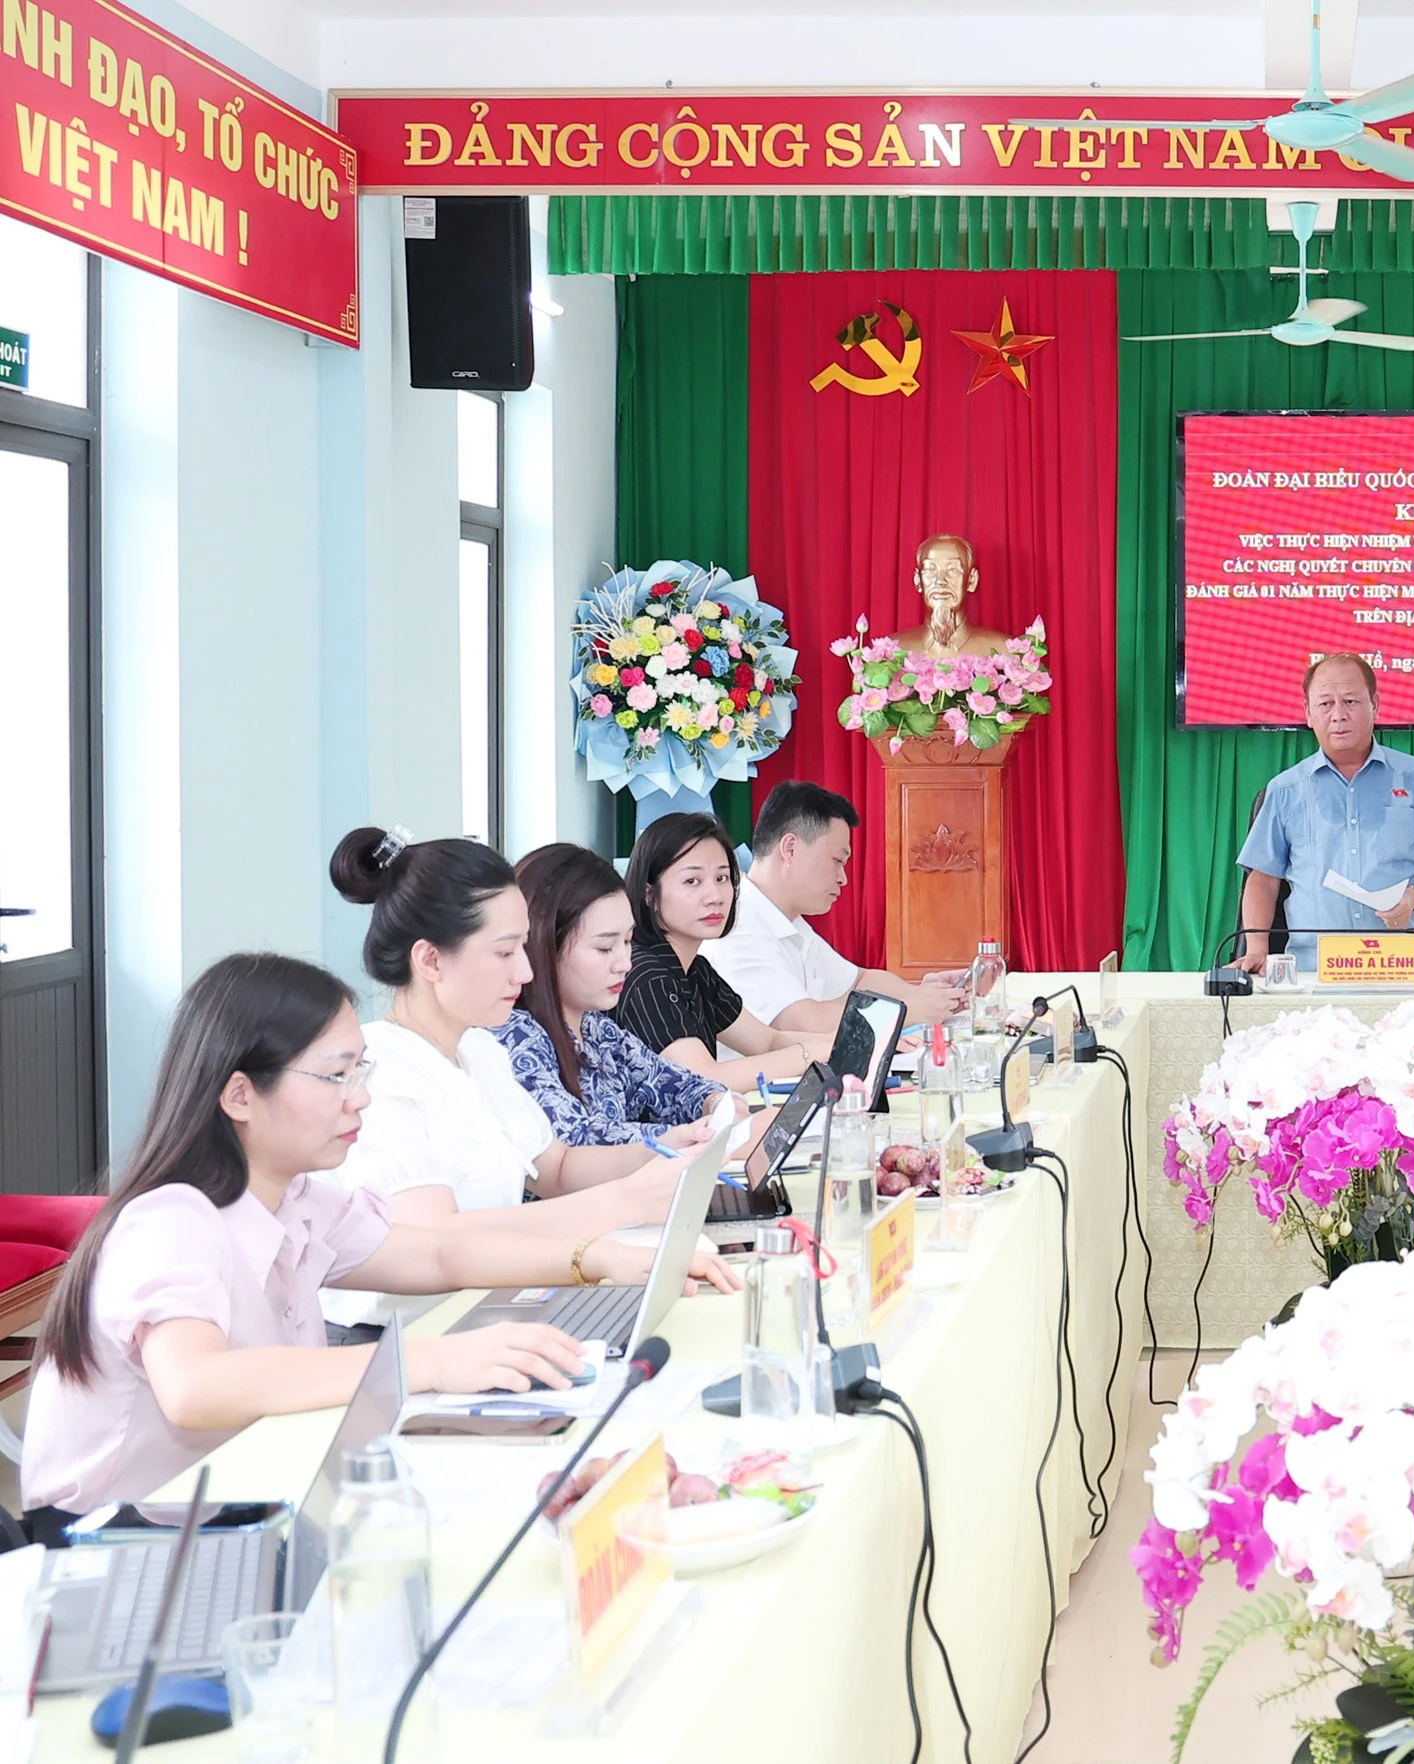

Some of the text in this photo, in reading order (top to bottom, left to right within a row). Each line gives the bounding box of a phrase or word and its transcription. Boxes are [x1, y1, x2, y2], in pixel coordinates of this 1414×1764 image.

[0, 0, 73, 88] NH
[88, 36, 187, 153] ĐẠO,
[198, 96, 245, 173] TỔ
[254, 131, 339, 221] CHỨC
[15, 102, 119, 212] VIỆT
[403, 101, 604, 168] ĐẢNG
[618, 105, 810, 179] CỘNG
[825, 101, 967, 168] SẢN
[982, 107, 1148, 182] VIỆT
[1367, 957, 1376, 968] A
